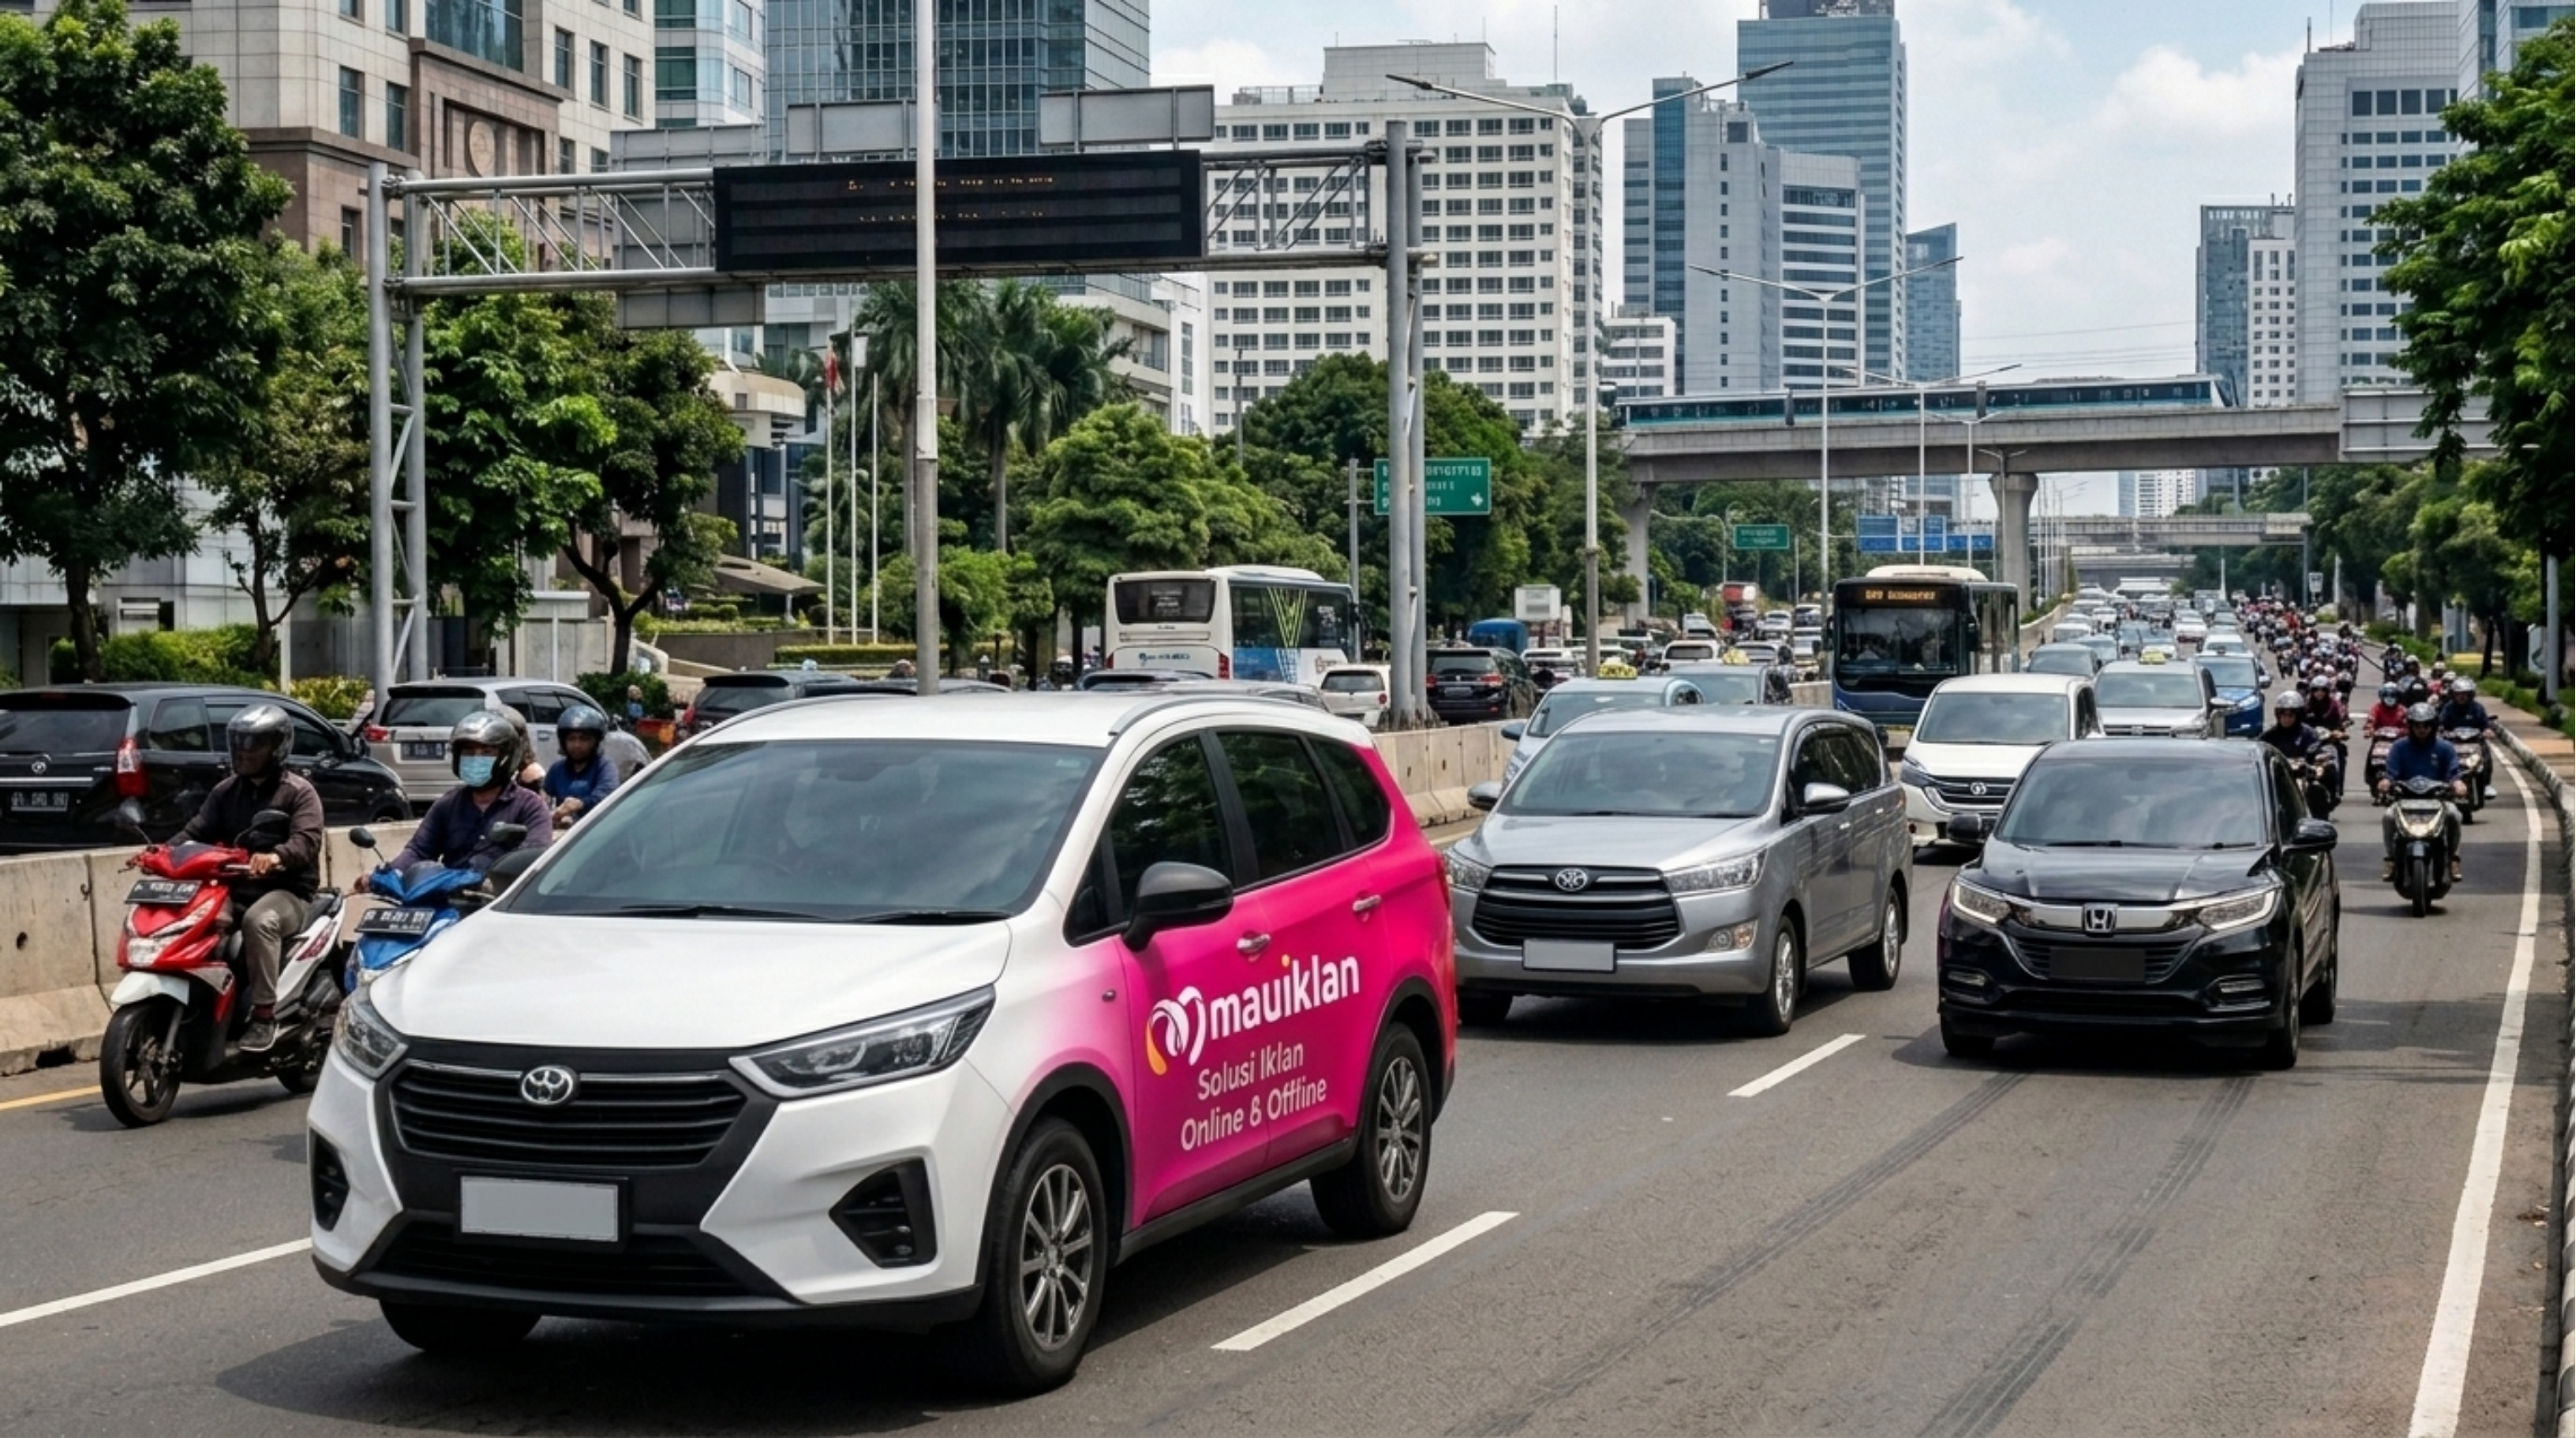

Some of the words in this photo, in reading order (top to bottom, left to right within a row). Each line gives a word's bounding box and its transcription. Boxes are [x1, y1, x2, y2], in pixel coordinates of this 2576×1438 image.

[1210, 954, 1360, 1040] mauiklan
[1198, 1051, 1255, 1101] Solusi
[1261, 1041, 1304, 1080] Iklan
[1181, 1106, 1245, 1151] Online
